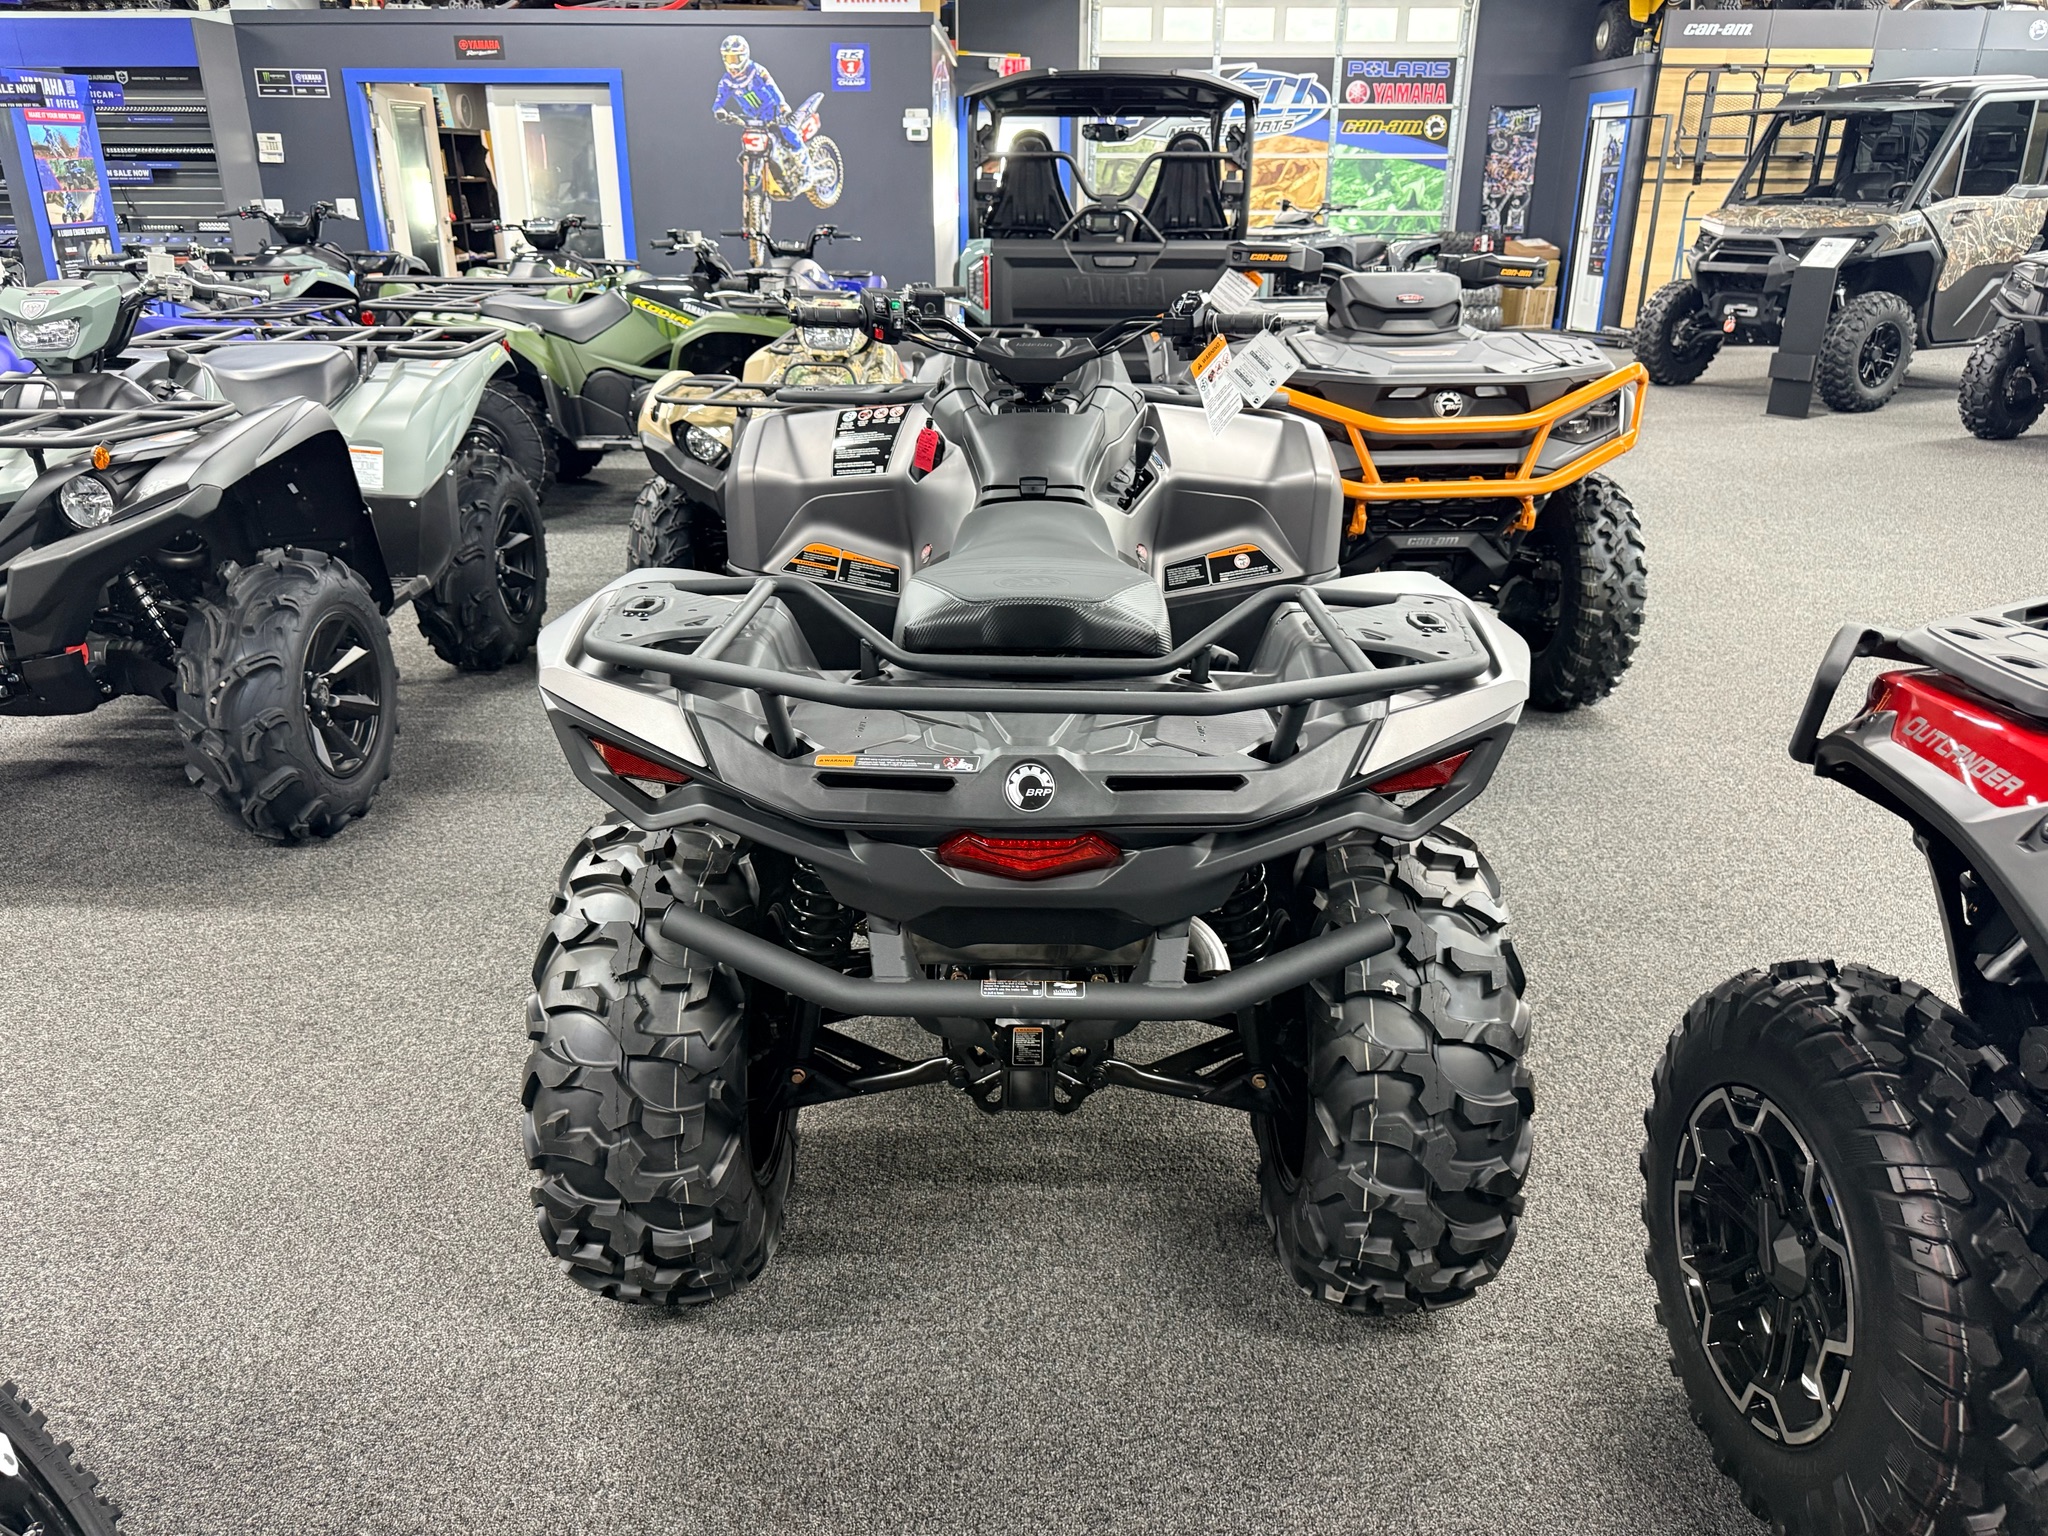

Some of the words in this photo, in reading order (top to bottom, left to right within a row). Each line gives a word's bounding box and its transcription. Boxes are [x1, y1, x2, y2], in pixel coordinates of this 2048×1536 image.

[1683, 23, 1754, 36] can-am
[467, 39, 500, 50] YAMAHA
[846, 61, 856, 73] 1
[1004, 58, 1026, 76] EXIT
[1347, 60, 1451, 78] POLARIS
[15, 84, 37, 94] NOW
[1372, 82, 1447, 104] YAMAHA
[1341, 119, 1424, 136] can-am
[114, 169, 132, 177] SALE
[132, 169, 149, 177] NOW
[1063, 276, 1168, 304] YAMAHA
[1201, 341, 1221, 364] WARNING
[1902, 716, 2025, 797] OUTLANDER
[1025, 788, 1052, 797] BRP
